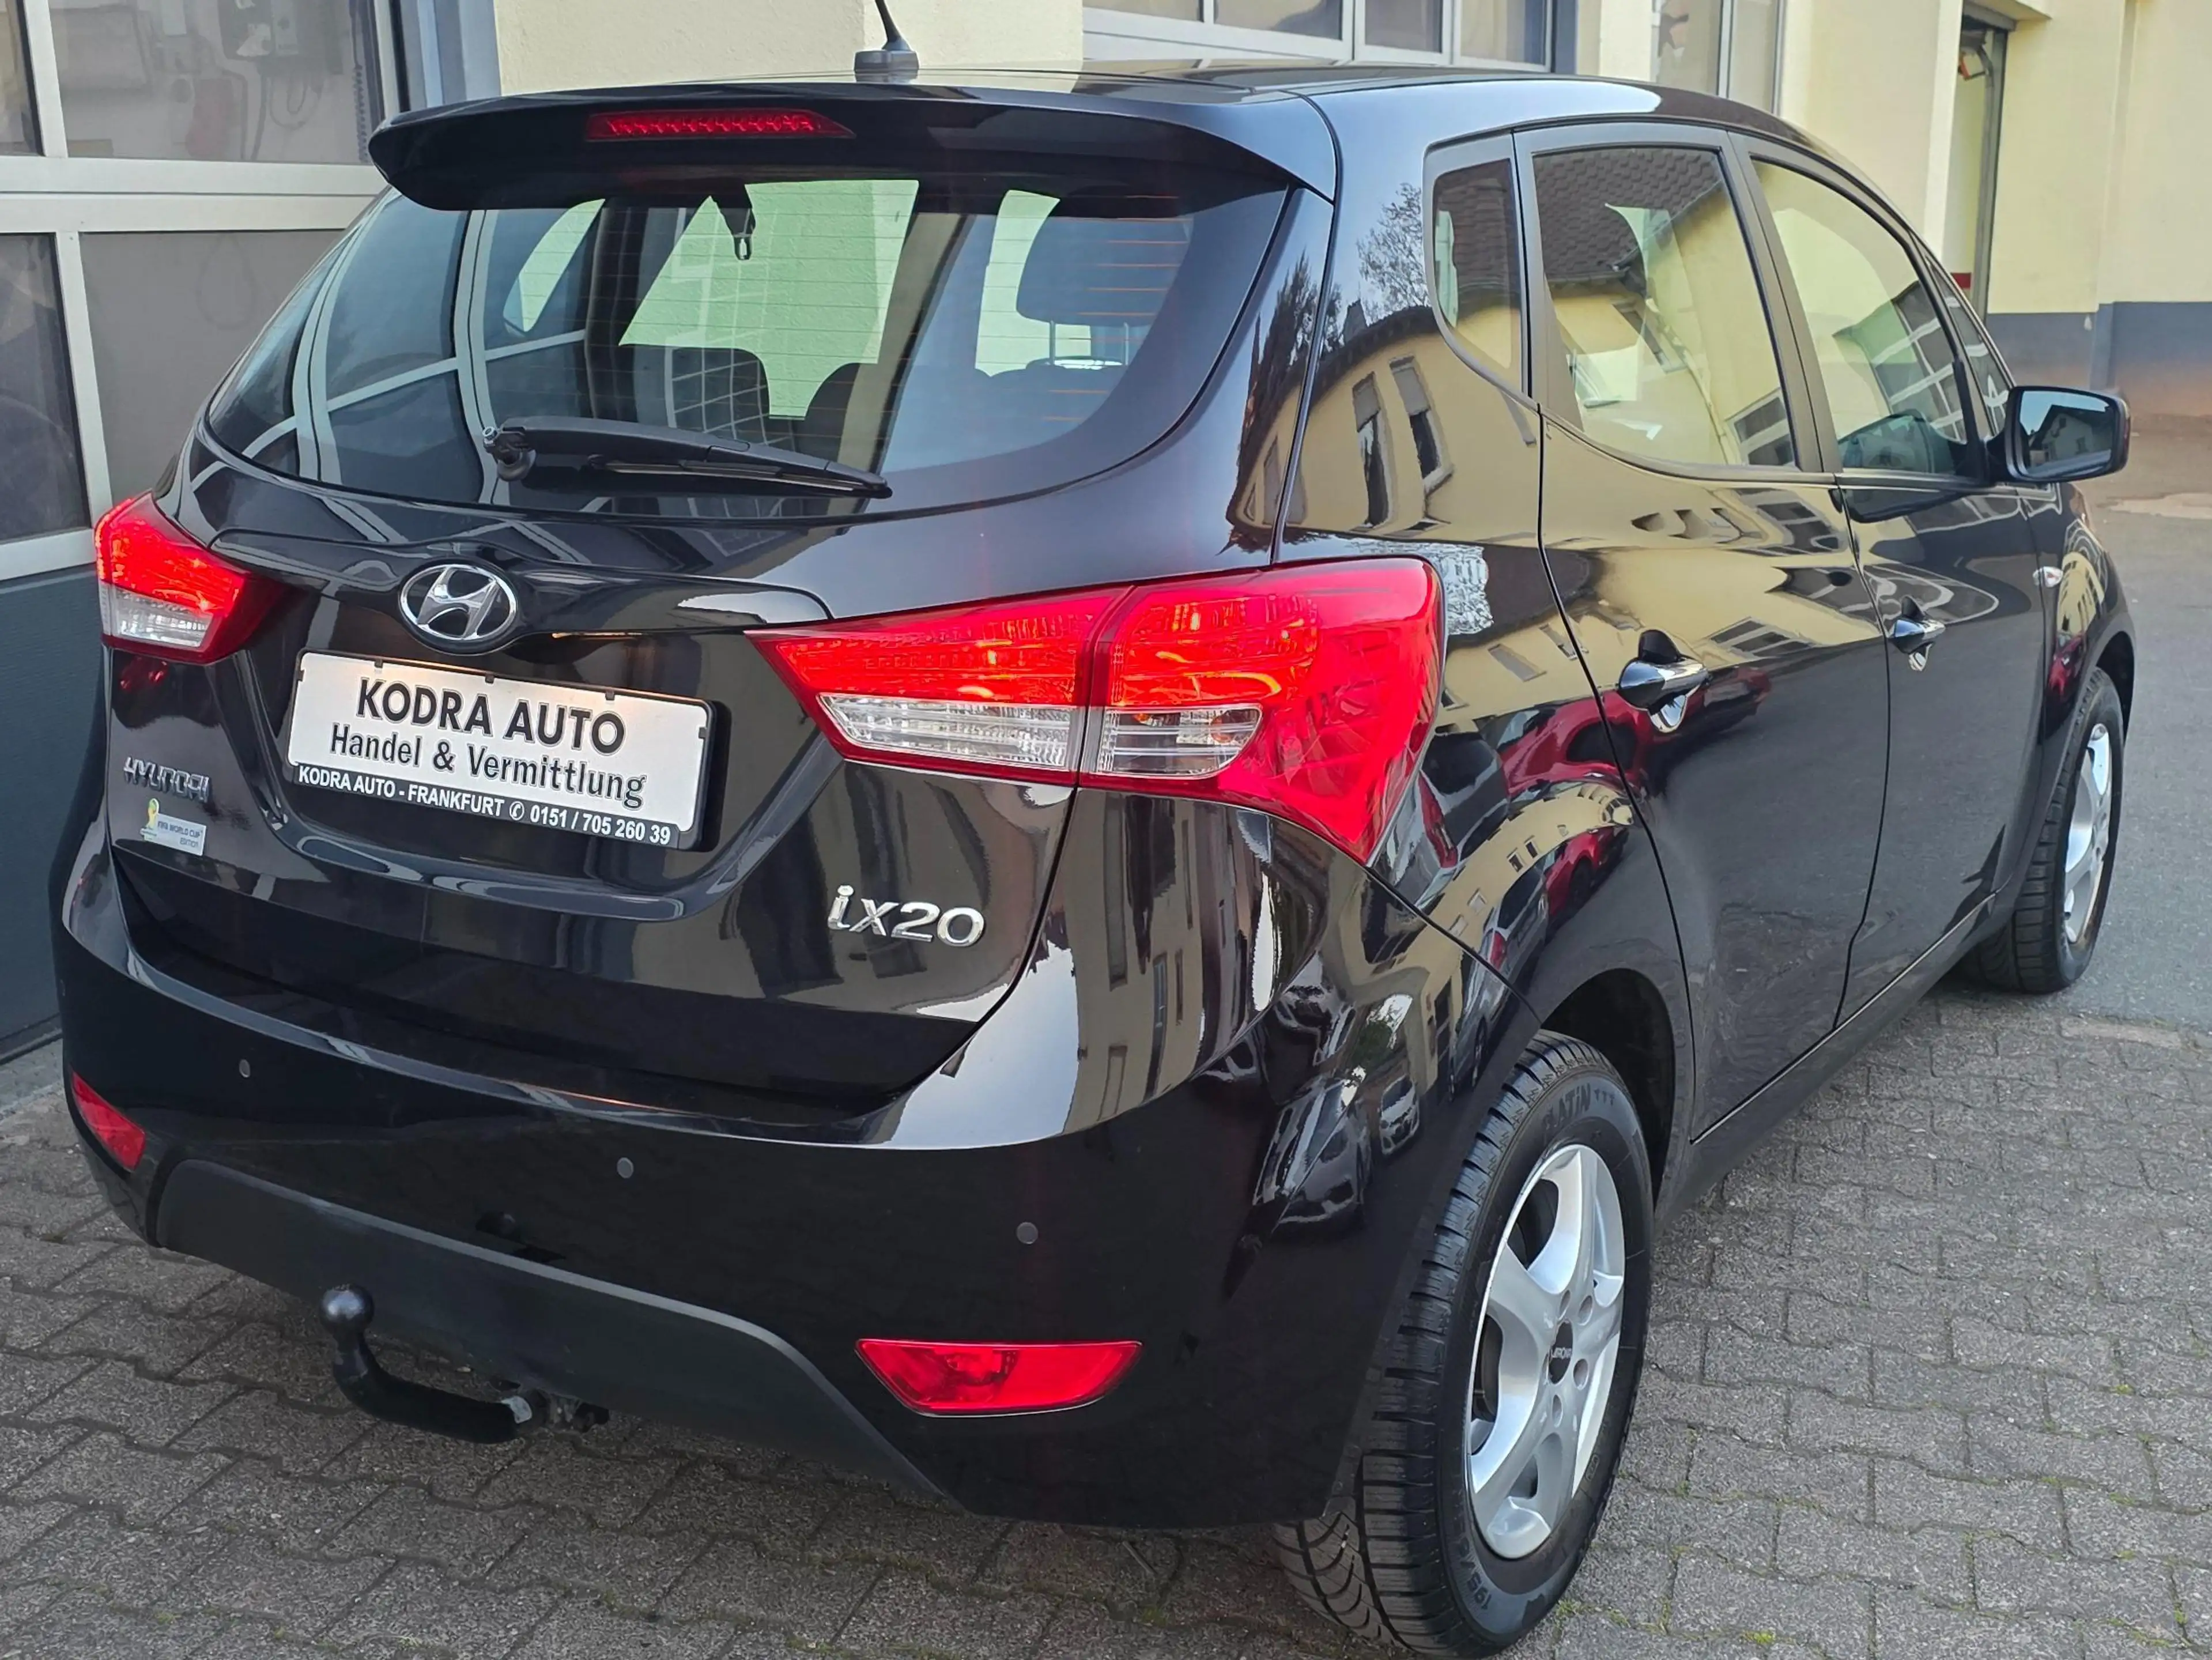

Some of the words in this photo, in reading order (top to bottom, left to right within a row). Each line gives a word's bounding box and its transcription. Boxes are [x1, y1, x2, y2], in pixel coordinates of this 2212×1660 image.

[356, 677, 493, 737] KODRA
[503, 699, 626, 756] AUTO
[299, 765, 352, 791] KODRA
[353, 775, 396, 798] AUTO
[407, 784, 505, 817] FRANKFURT
[530, 805, 567, 828] 0151
[571, 812, 578, 831] /
[582, 813, 611, 835] 705
[616, 818, 645, 841] 260
[650, 824, 671, 846] 39
[330, 722, 422, 767] Handel
[432, 738, 456, 772] &
[467, 743, 647, 810] Vermittlung
[828, 885, 984, 947] ix20
